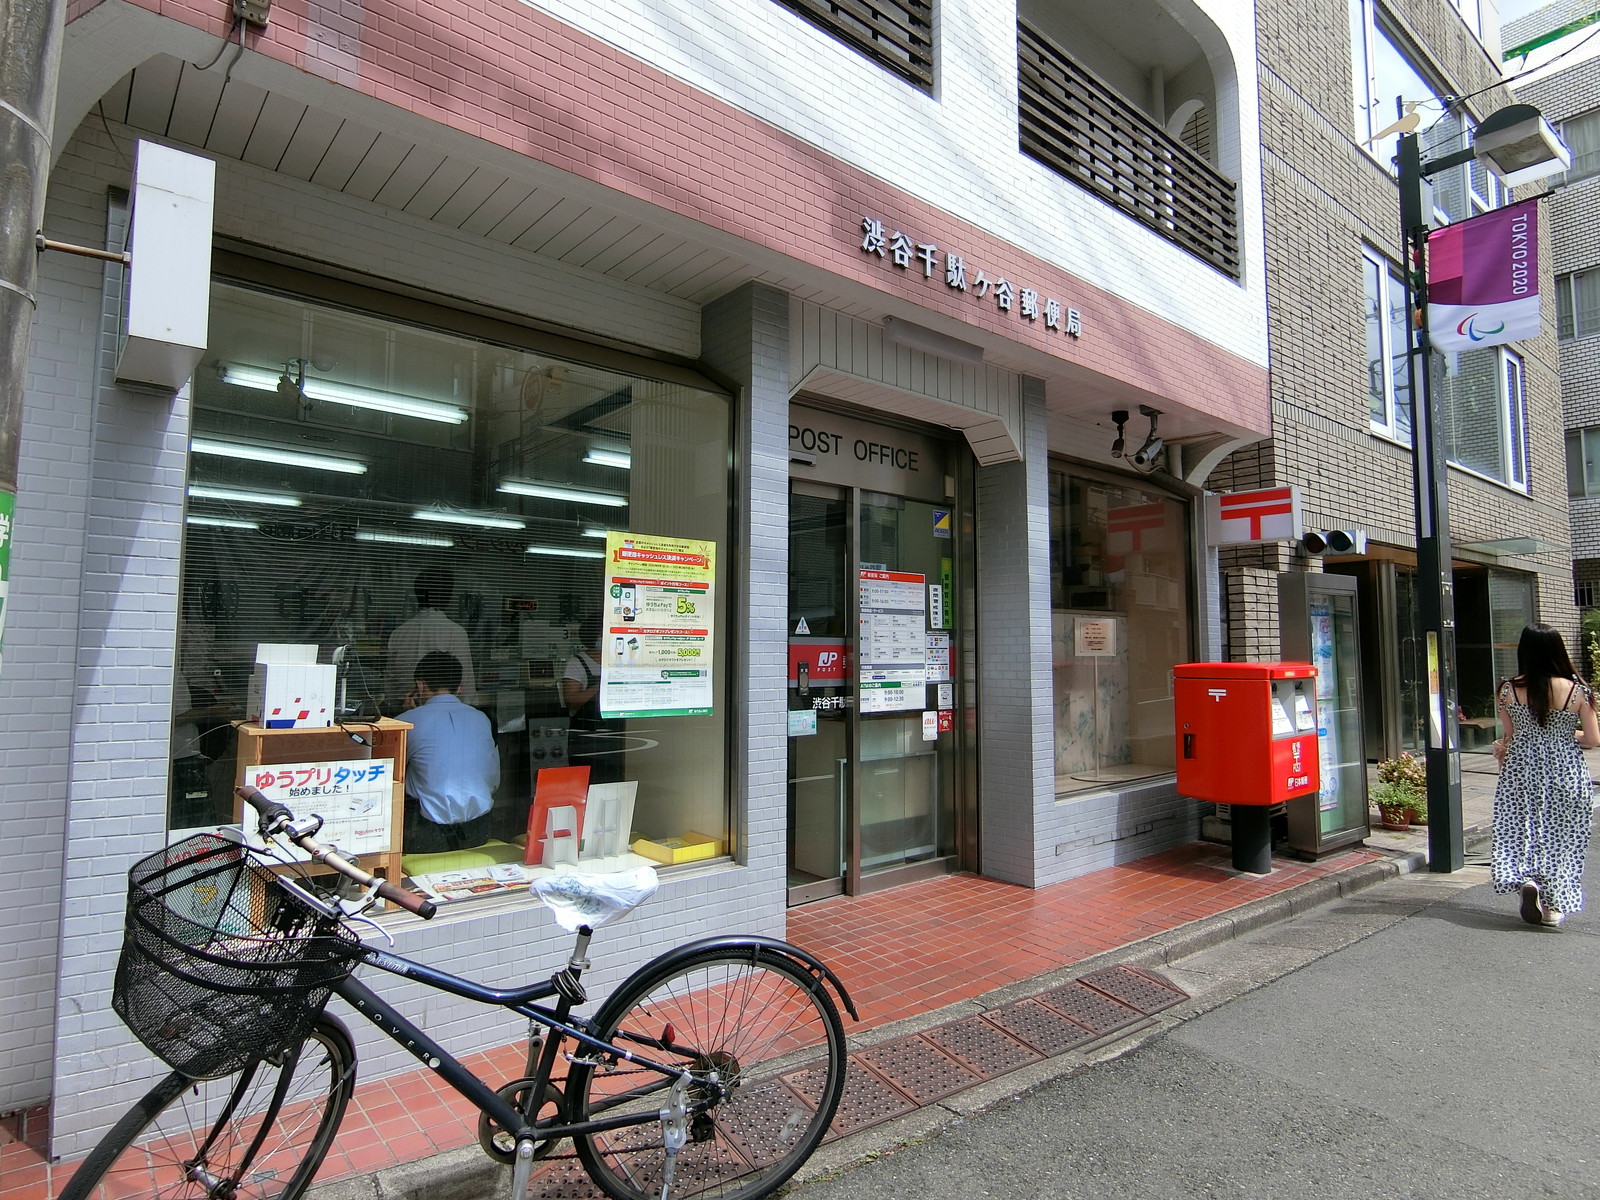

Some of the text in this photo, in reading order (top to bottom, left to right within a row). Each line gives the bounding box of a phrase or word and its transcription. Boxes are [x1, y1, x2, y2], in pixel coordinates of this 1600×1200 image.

[1512, 213, 1528, 295] TOKYO 2020
[789, 424, 919, 472] POST OFFICE
[676, 597, 696, 614] 5%
[255, 764, 385, 791] ゆうプリタッチ
[357, 999, 430, 1061] ROVER
